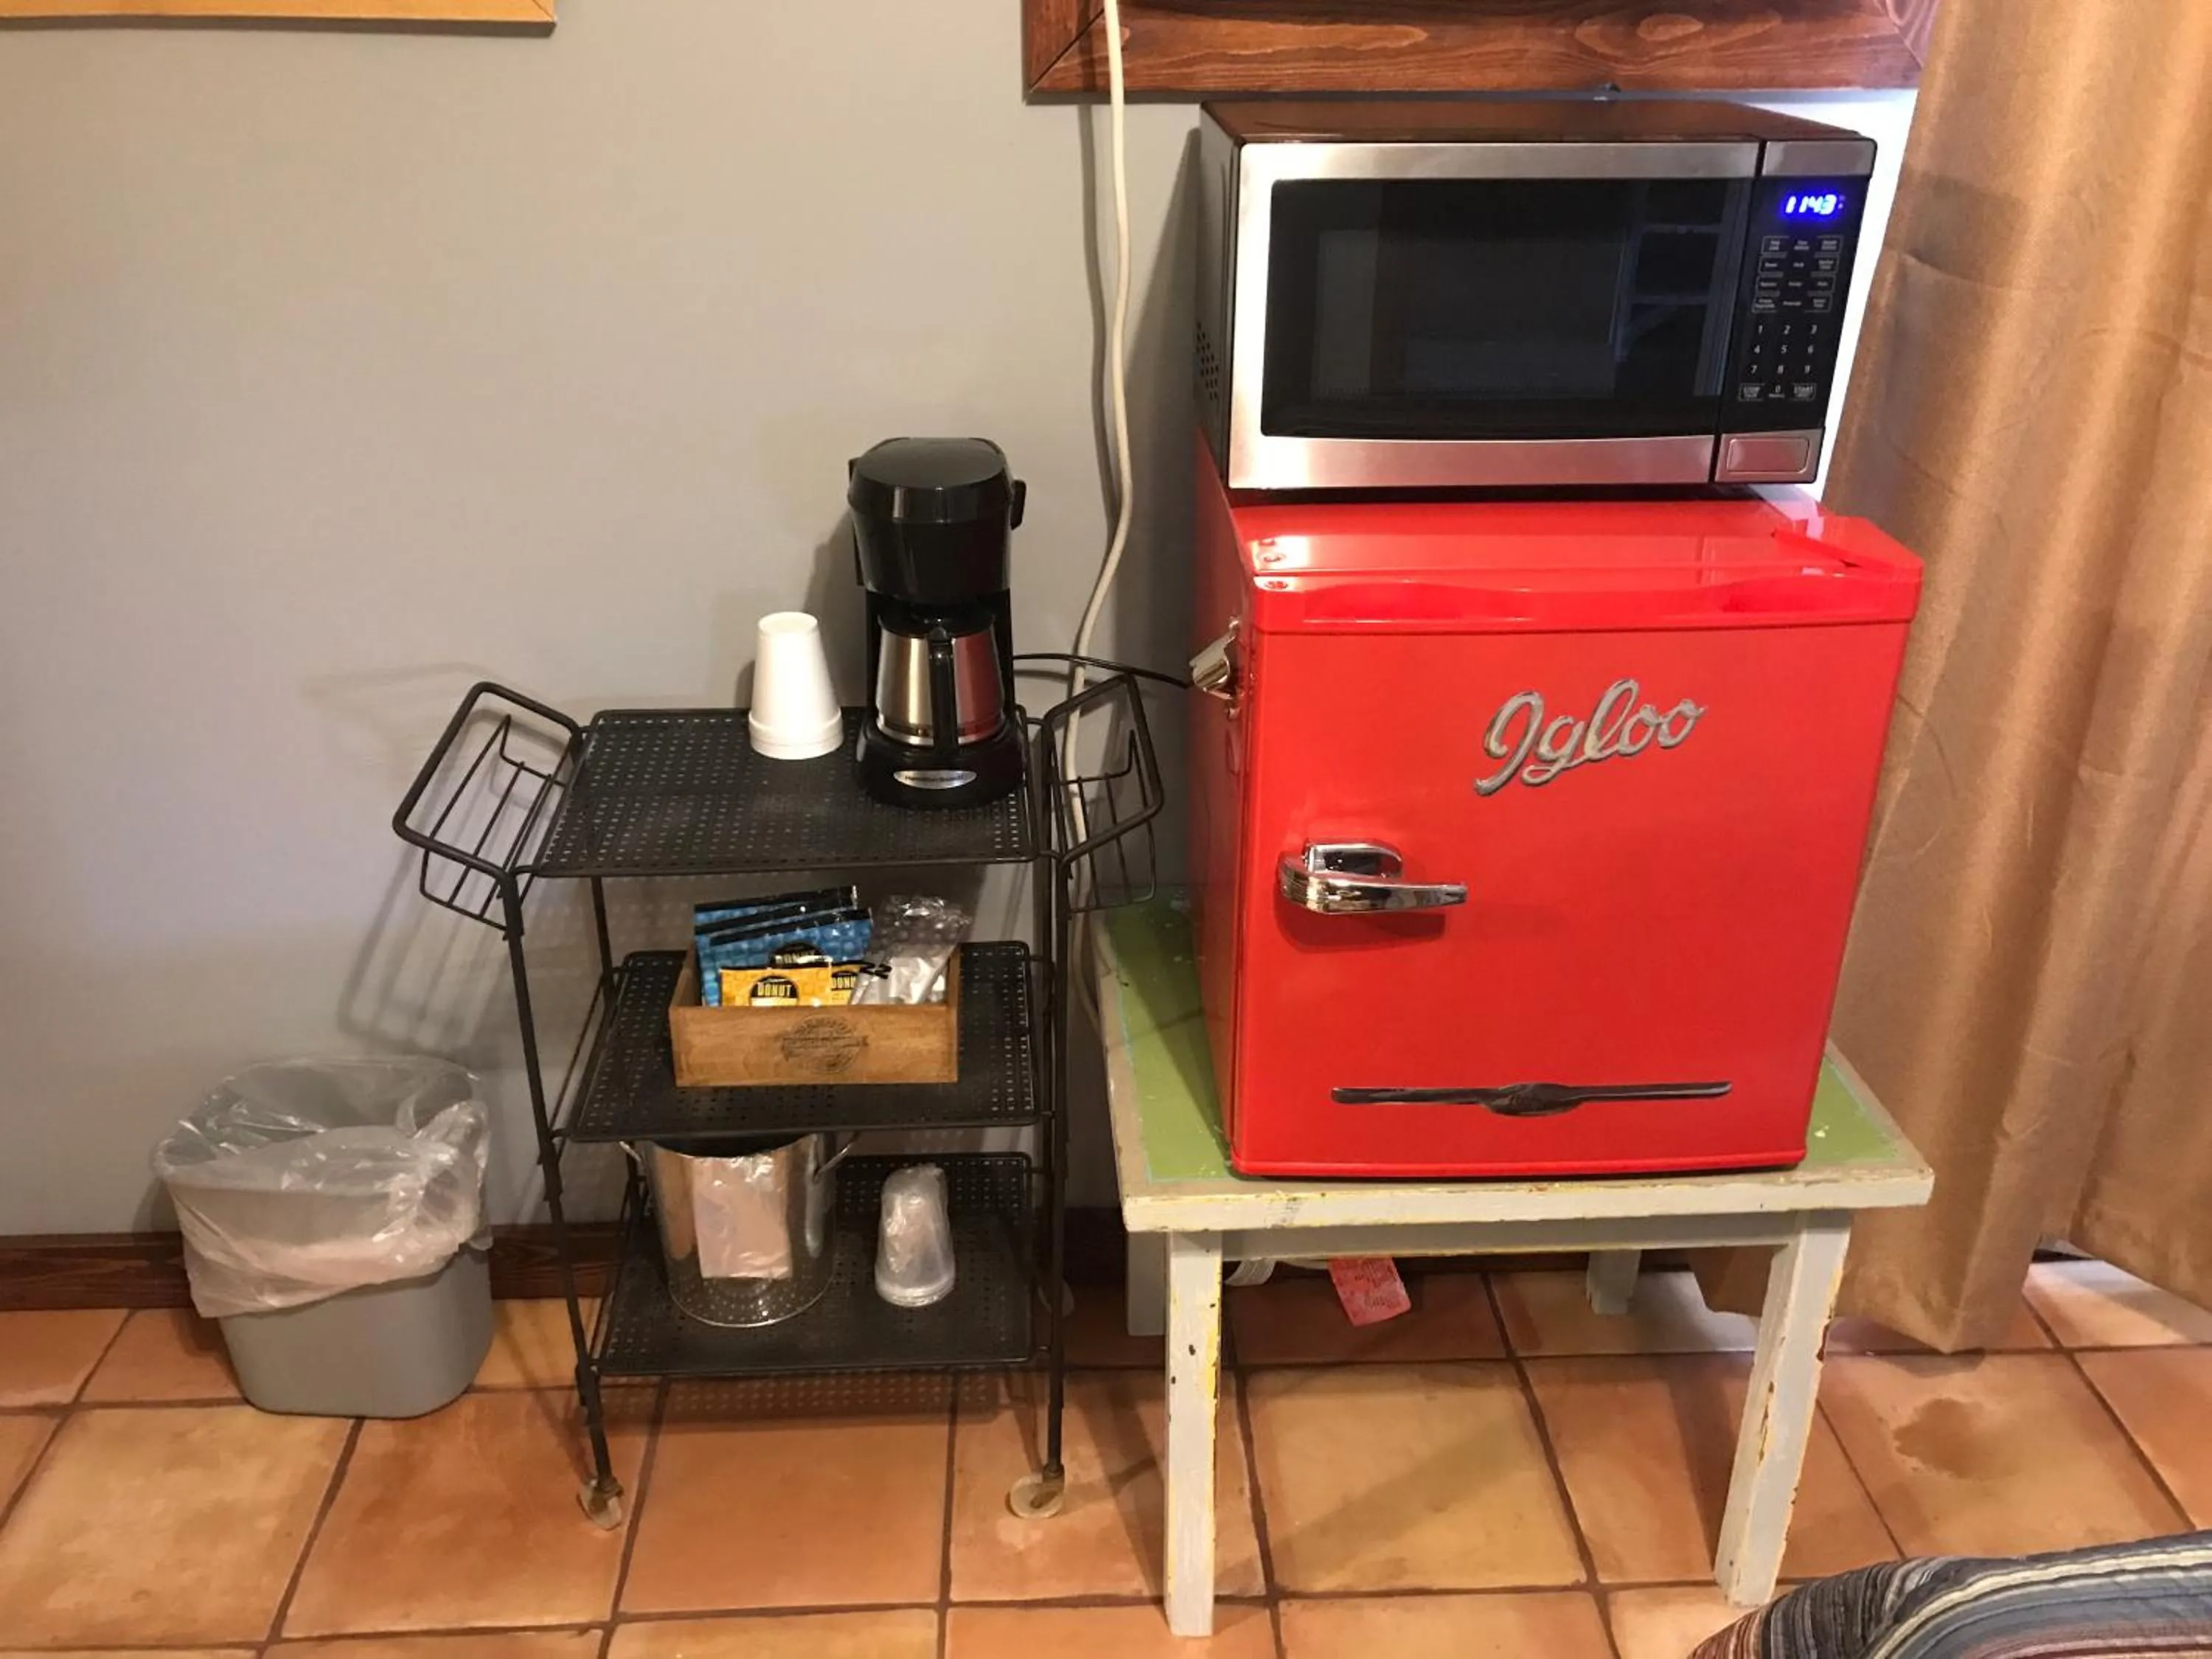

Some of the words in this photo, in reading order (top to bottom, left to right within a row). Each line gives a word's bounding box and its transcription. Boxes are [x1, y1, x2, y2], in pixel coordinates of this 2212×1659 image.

[1759, 324, 1763, 334] 1
[1784, 324, 1791, 335] 2
[1754, 344, 1760, 354] 4
[1781, 344, 1788, 354] 5
[1750, 365, 1758, 375] 7
[1474, 678, 1708, 796] Igloo
[757, 982, 792, 997] DONUT
